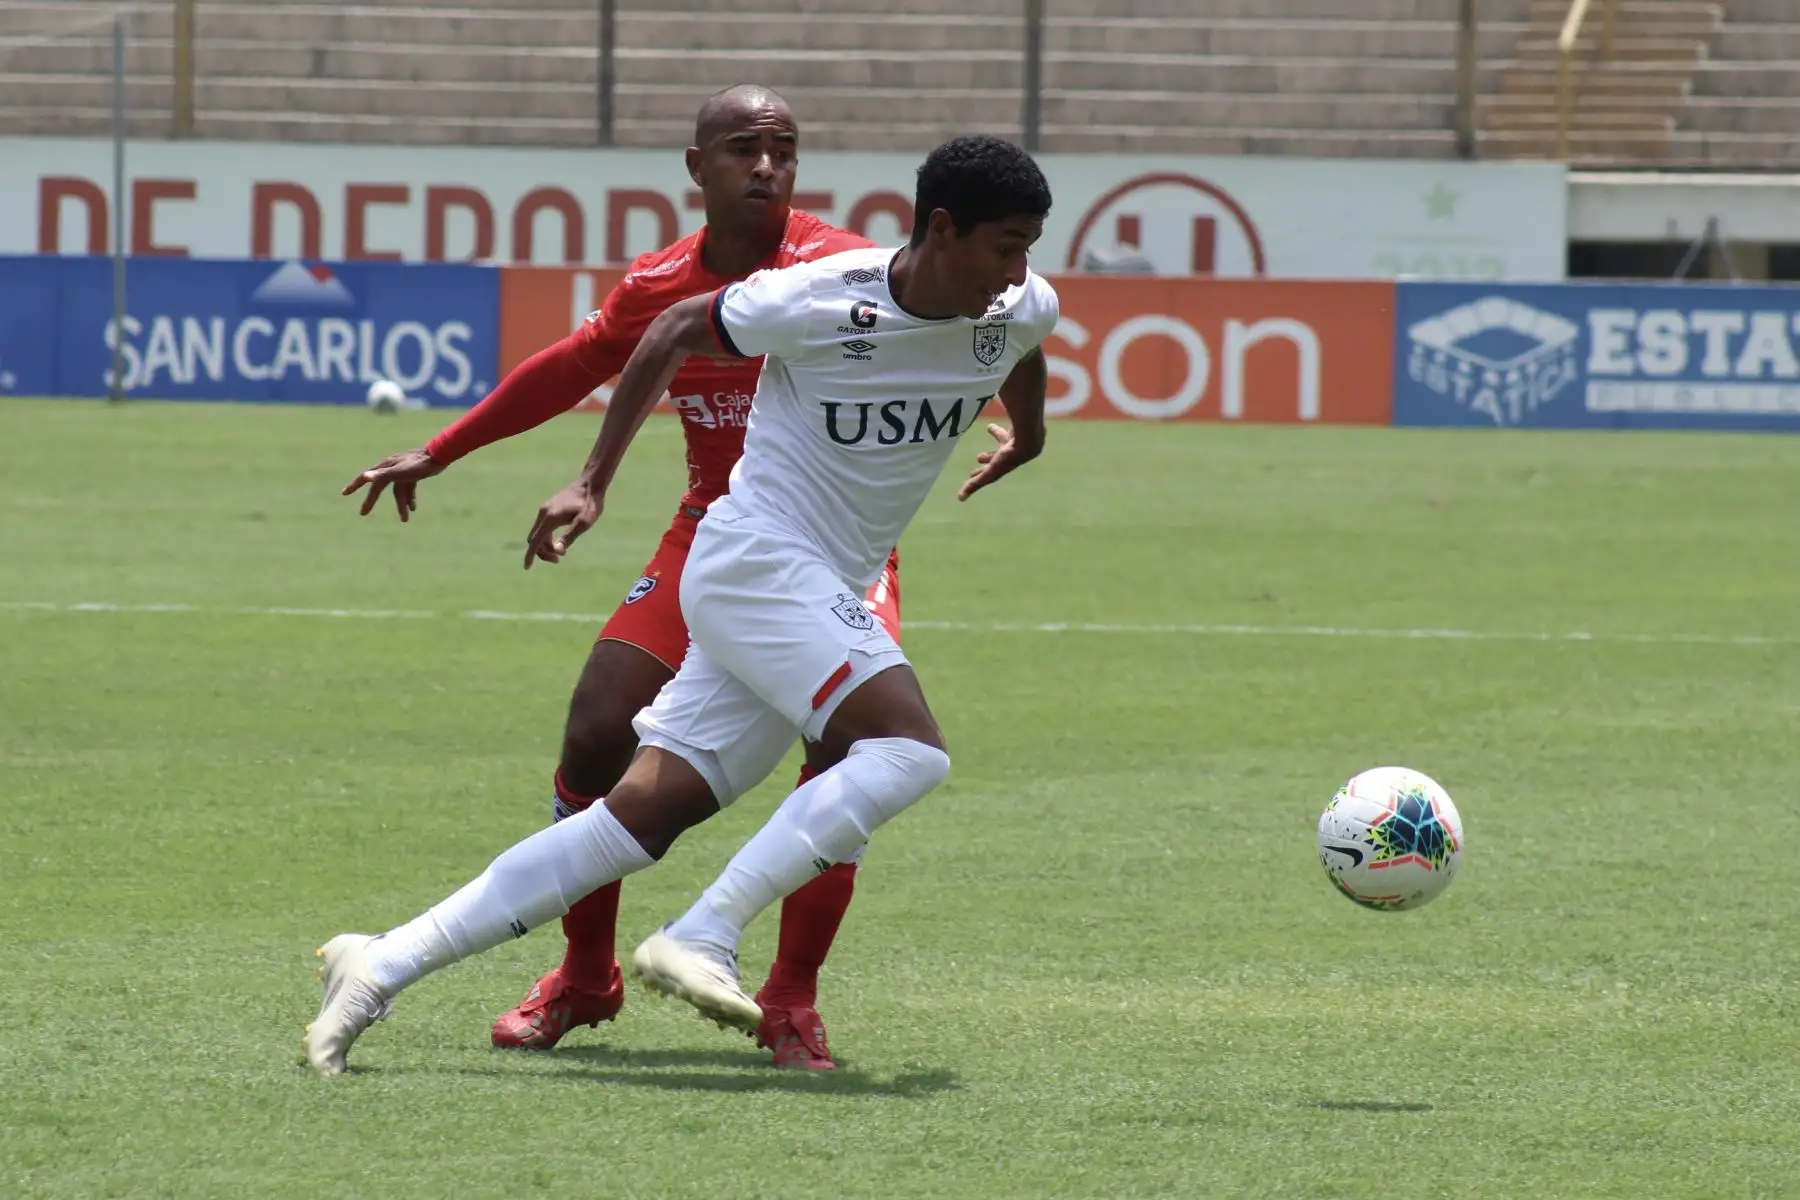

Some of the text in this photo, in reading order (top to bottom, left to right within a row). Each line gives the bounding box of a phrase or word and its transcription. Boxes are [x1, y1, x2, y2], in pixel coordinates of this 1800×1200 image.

[979, 312, 1015, 321] ATORADE
[837, 326, 881, 335] GATORA
[1587, 309, 1800, 377] ESTA
[103, 315, 473, 397] SAN CARLOS
[843, 352, 873, 361] umbro
[713, 389, 751, 412] Caja
